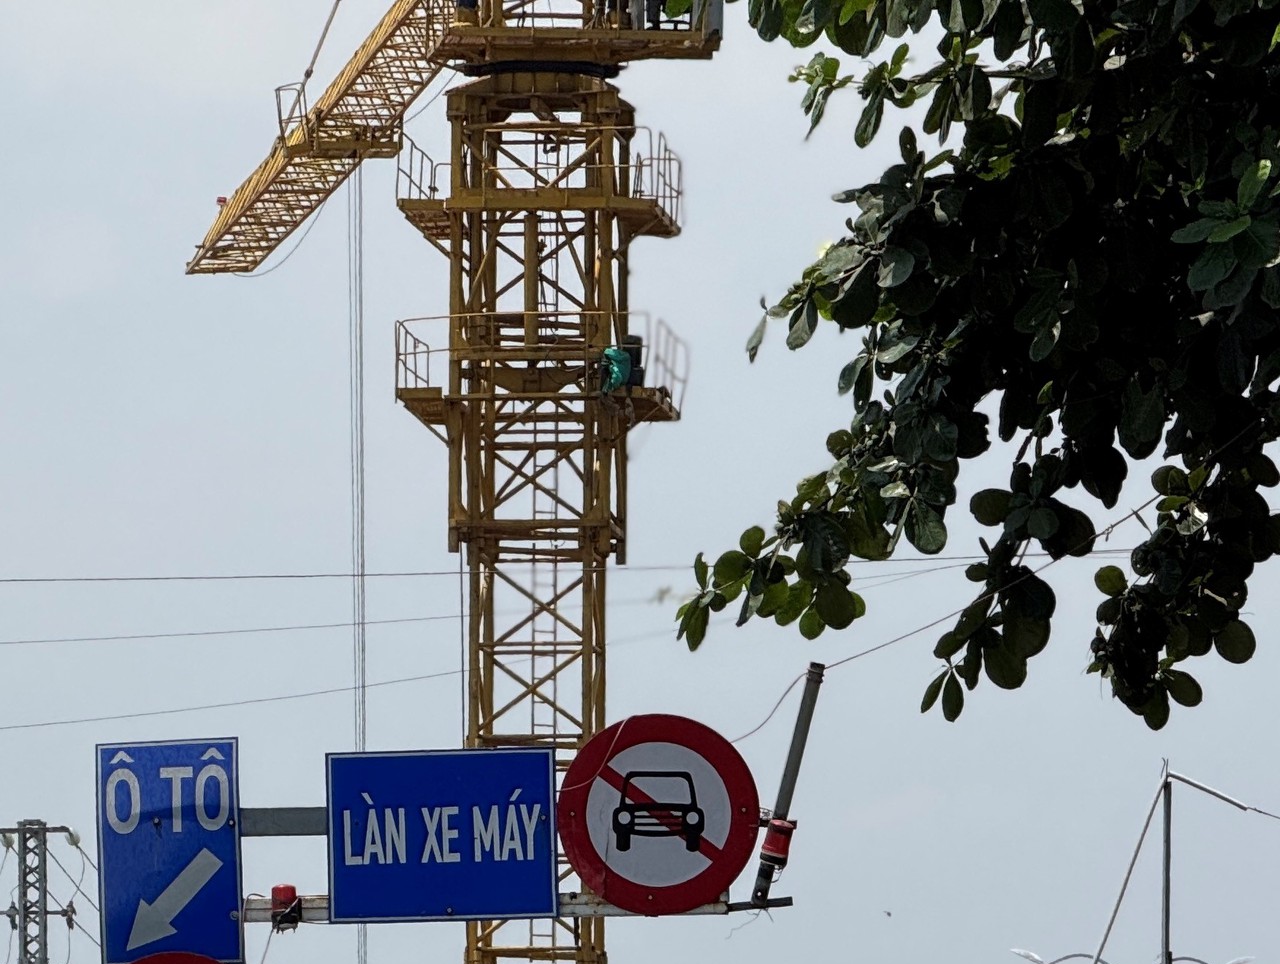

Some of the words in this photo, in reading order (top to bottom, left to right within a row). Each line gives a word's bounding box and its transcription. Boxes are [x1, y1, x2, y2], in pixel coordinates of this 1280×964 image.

[106, 750, 141, 834] Ô
[160, 747, 229, 833] TÔ
[343, 792, 406, 866] LÀN
[421, 806, 460, 863] XE
[473, 789, 541, 862] MÁY
